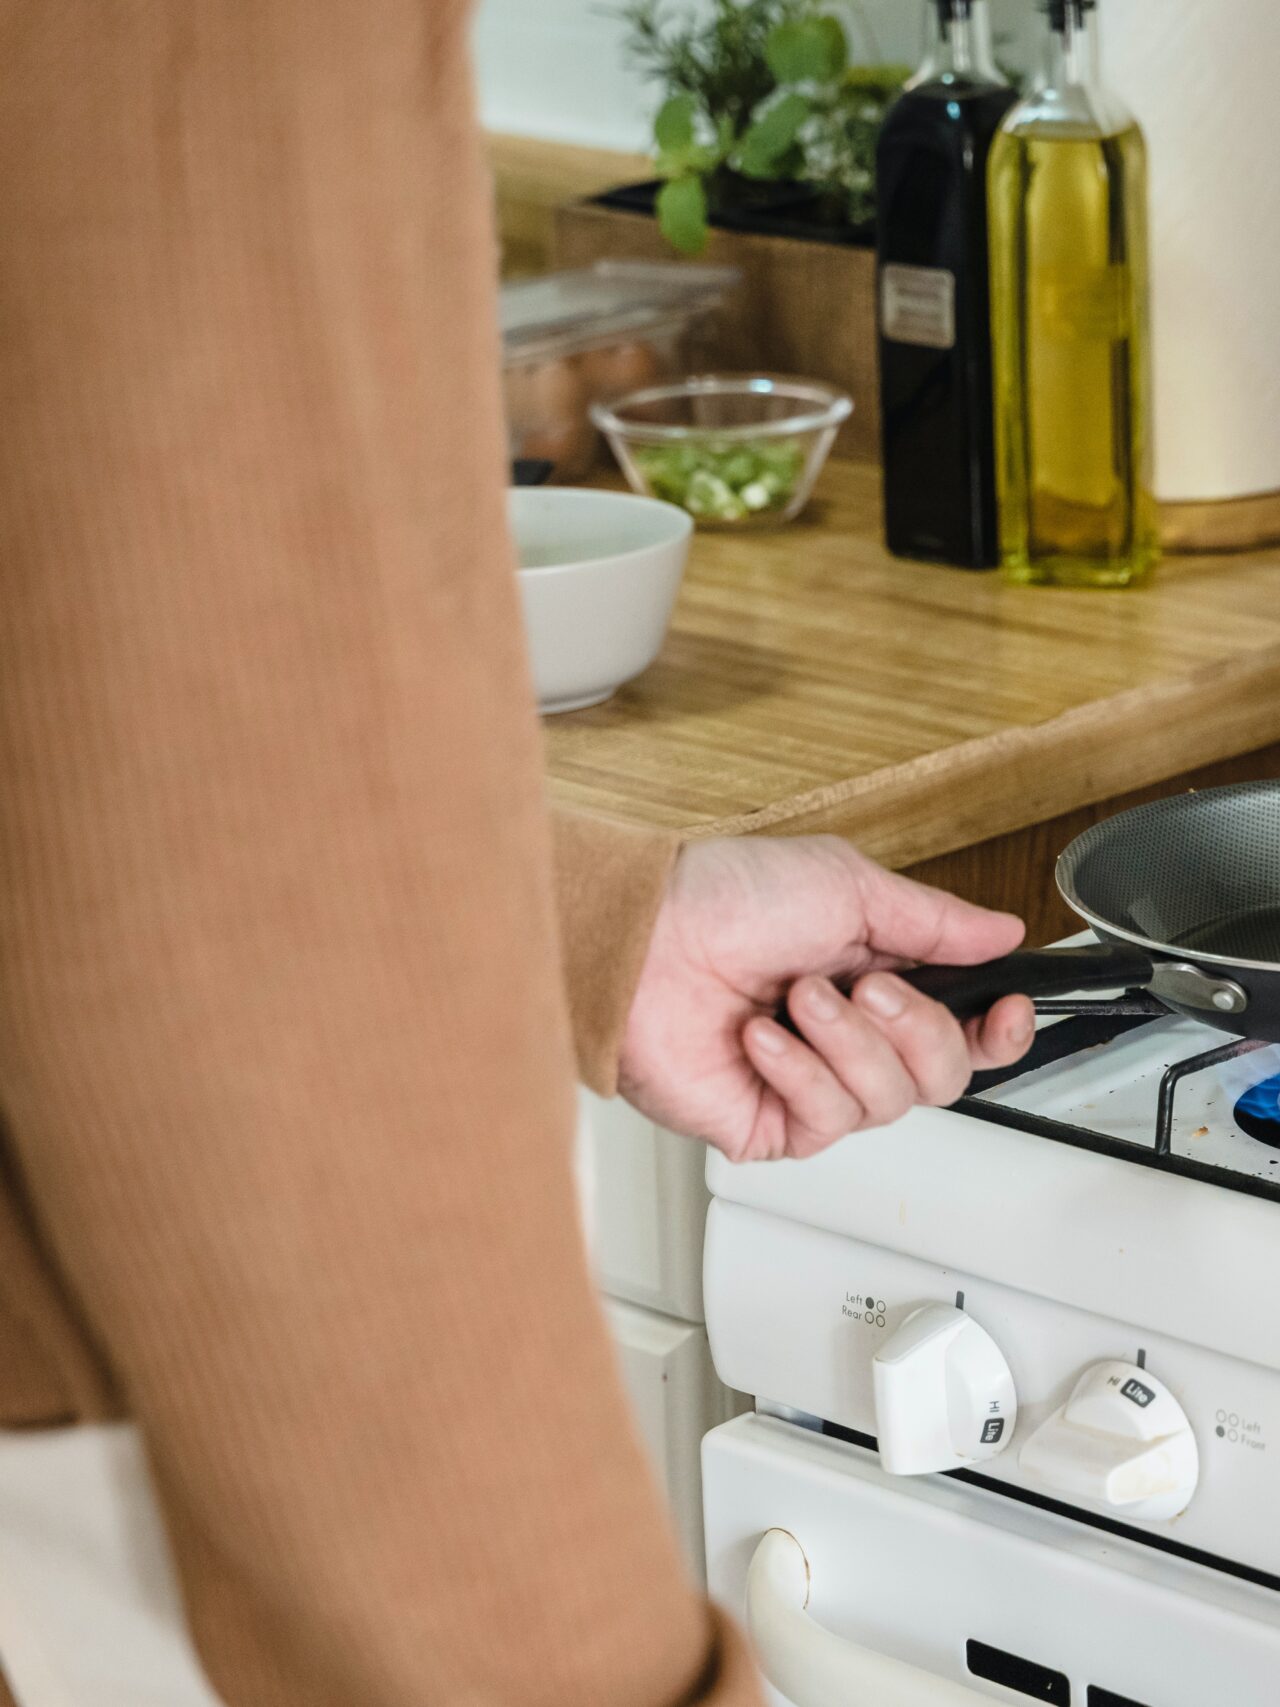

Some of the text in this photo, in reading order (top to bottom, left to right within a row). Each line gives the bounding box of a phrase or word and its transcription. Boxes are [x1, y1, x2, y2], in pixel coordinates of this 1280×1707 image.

[846, 1291, 862, 1305] Left
[842, 1304, 862, 1320] Rear
[1126, 1382, 1148, 1403] Lite
[985, 1422, 1000, 1441] Lite
[1242, 1418, 1261, 1434] Left
[1241, 1433, 1265, 1450] Front
